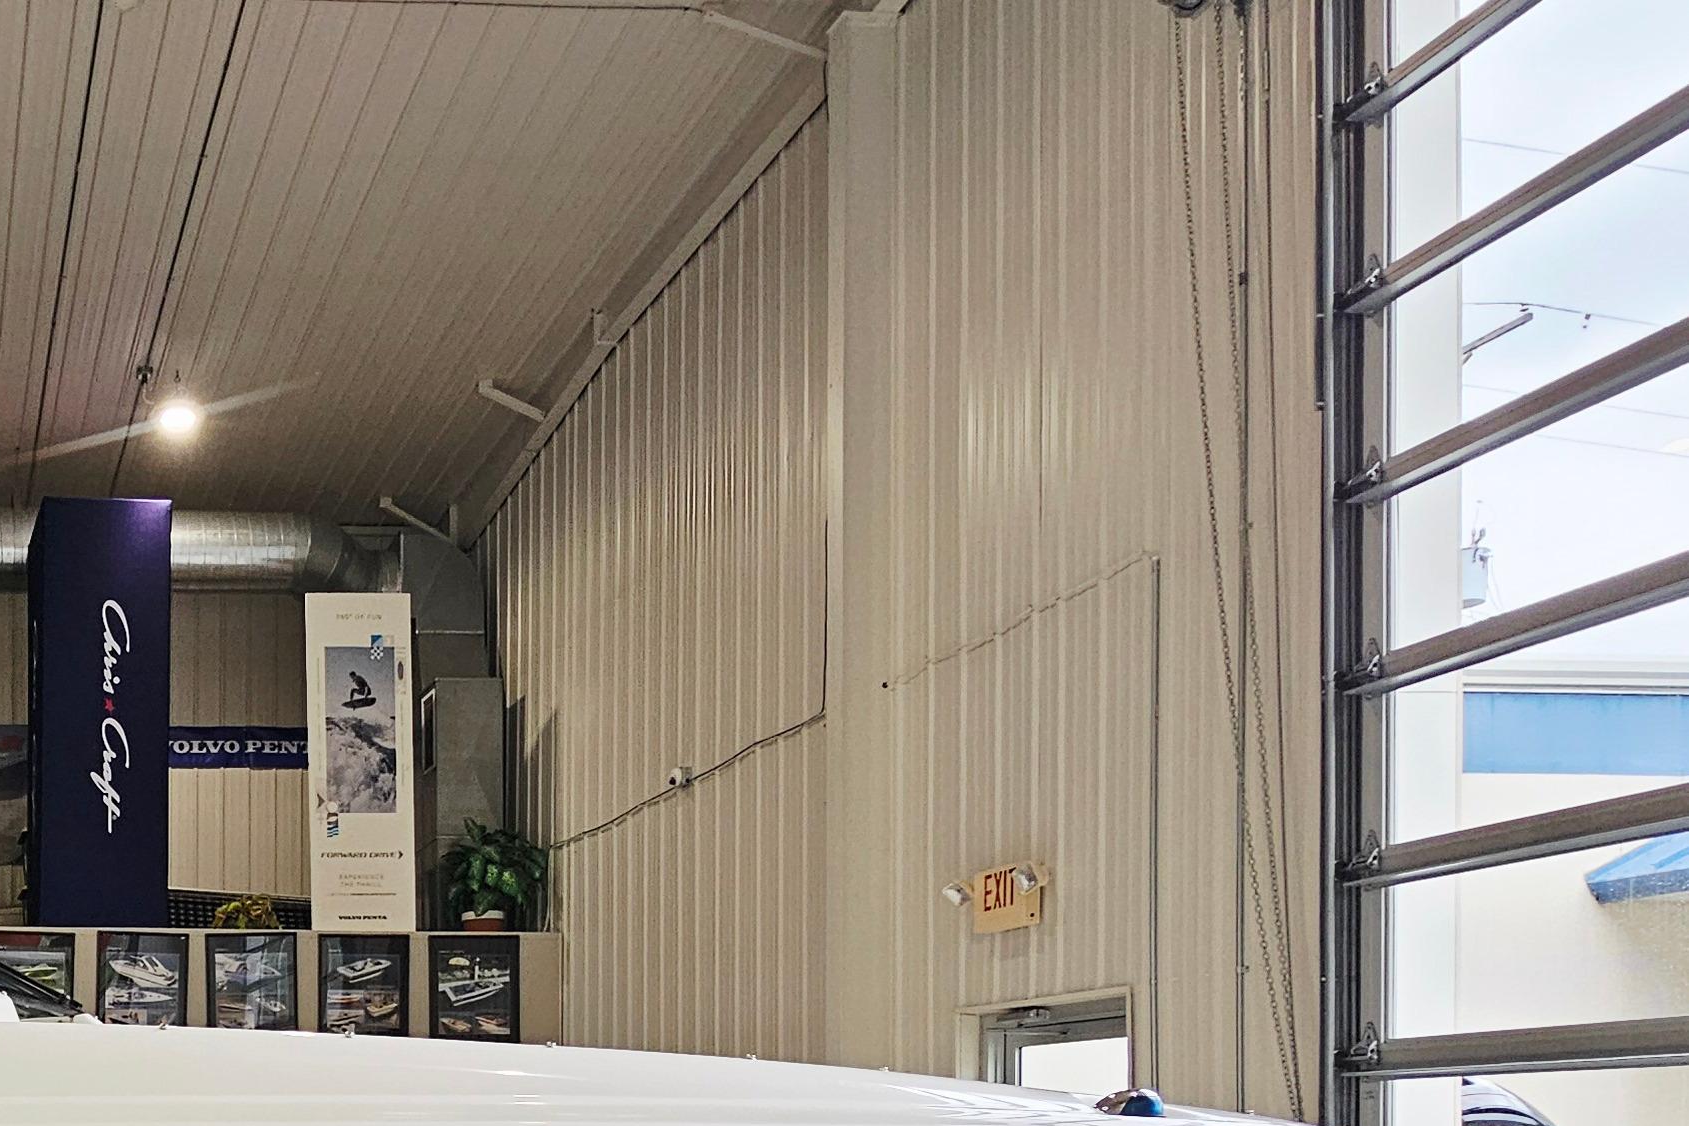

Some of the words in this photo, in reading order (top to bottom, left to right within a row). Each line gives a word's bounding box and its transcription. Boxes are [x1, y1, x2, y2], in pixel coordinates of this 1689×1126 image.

[101, 599, 130, 694] Chris
[89, 717, 130, 834] Craft
[169, 740, 240, 754] OLVO
